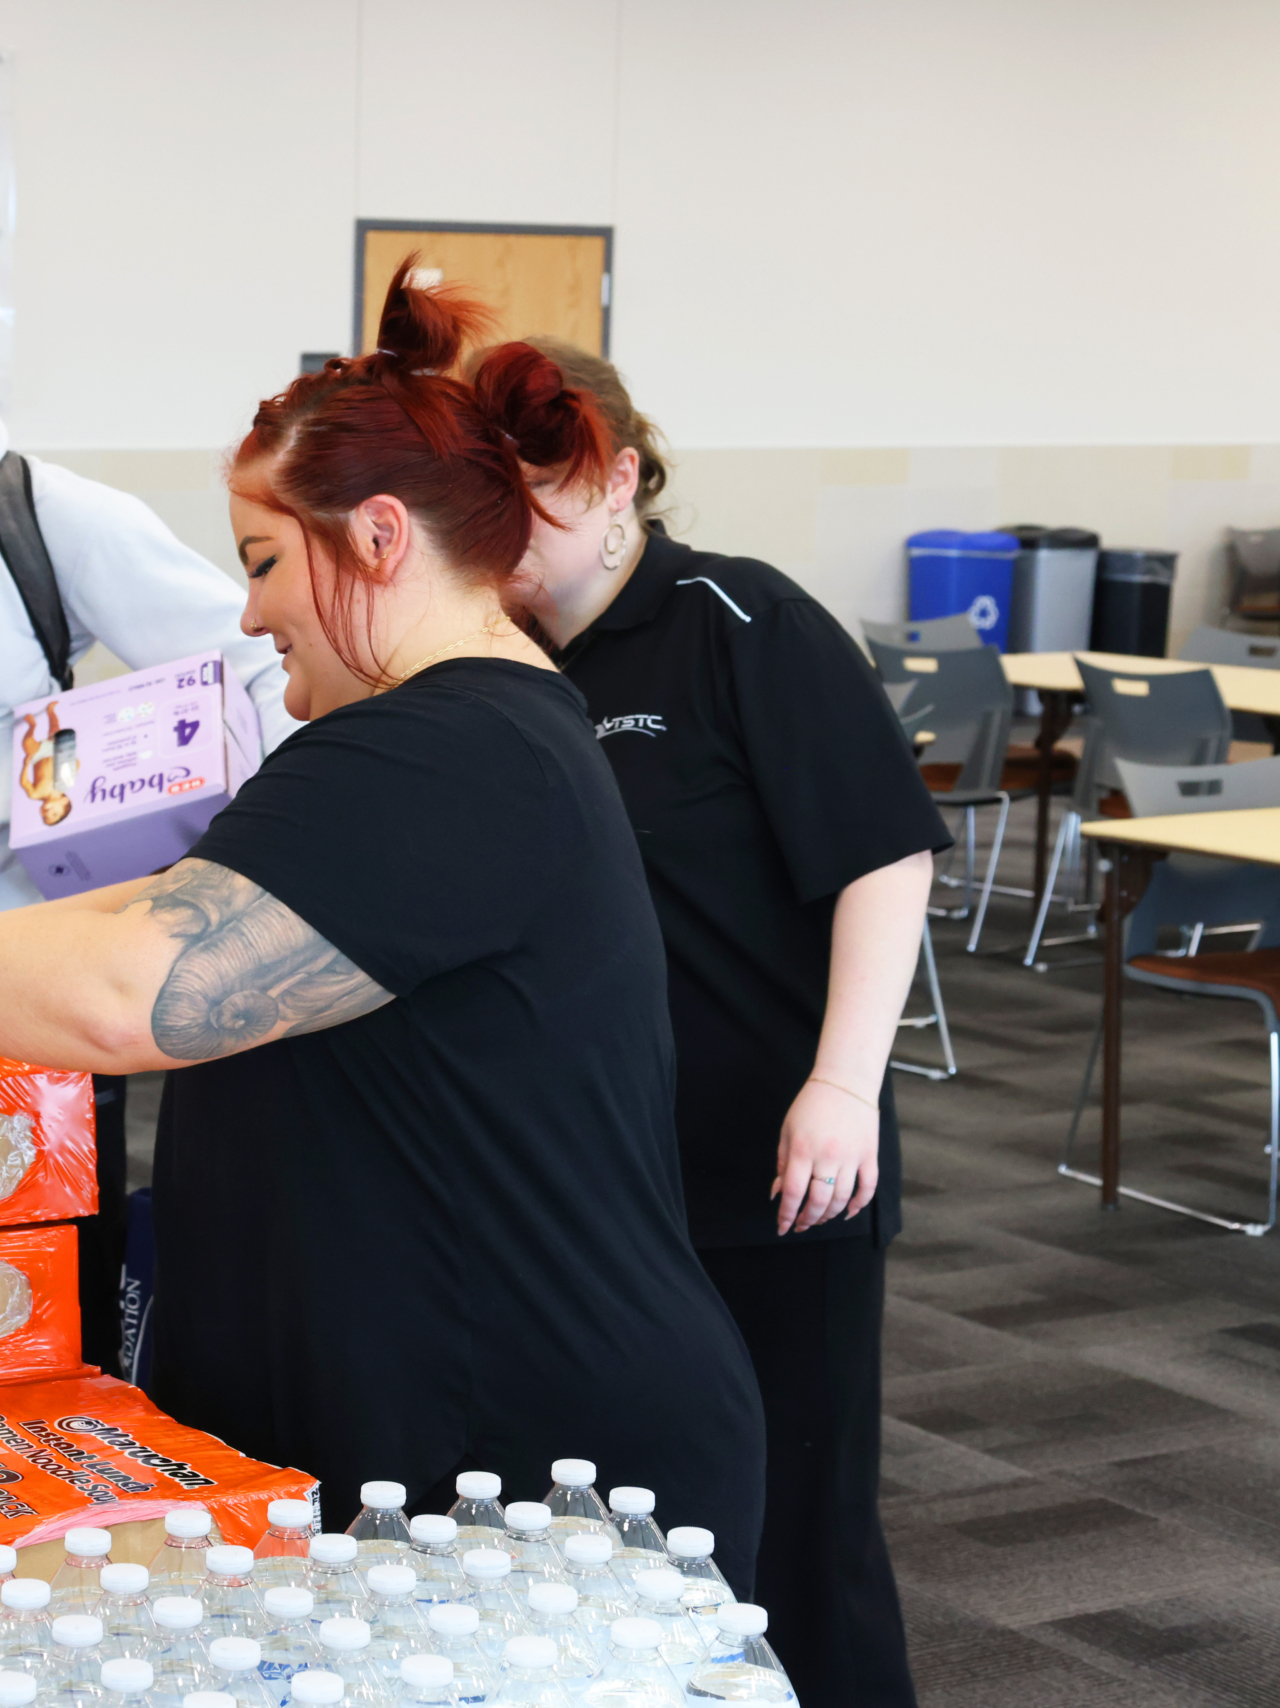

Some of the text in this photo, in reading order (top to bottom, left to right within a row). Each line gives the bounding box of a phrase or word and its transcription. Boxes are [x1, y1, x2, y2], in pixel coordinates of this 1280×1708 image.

[173, 718, 200, 748] 4
[611, 714, 664, 729] TSTC
[84, 772, 164, 804] baby
[18, 1418, 158, 1495] Instant Lunch
[20, 1447, 93, 1487] Noodle
[87, 1419, 219, 1490] Maruchan
